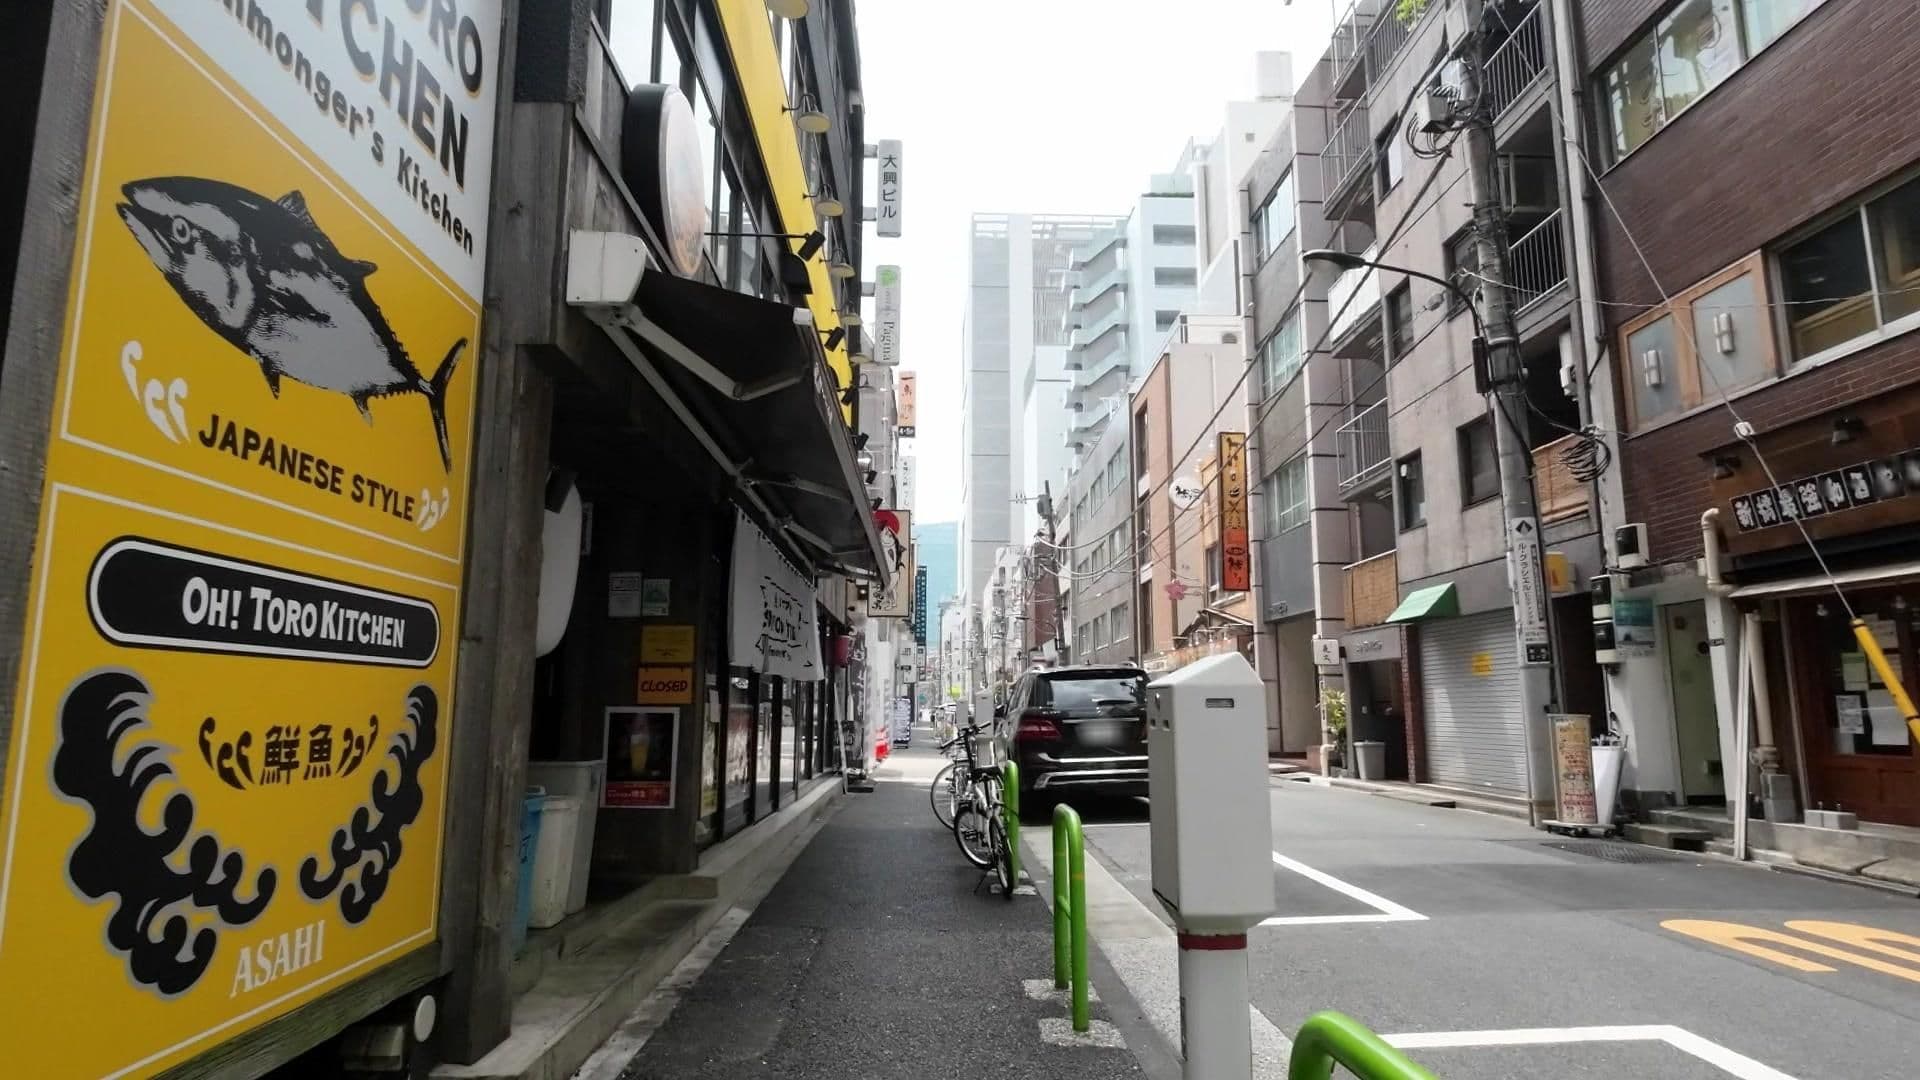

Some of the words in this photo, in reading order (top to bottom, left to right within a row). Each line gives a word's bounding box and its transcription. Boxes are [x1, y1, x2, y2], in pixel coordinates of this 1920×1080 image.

[398, 148, 475, 257] Kitchen
[881, 154, 898, 219] 大興ビル
[198, 413, 343, 496] JAPANESE
[351, 474, 416, 522] STYLE
[250, 587, 318, 638] TORO
[320, 600, 405, 649] KITCHEN
[639, 679, 688, 694] CLOSED
[260, 722, 333, 786] 鮮魚
[229, 919, 327, 999] ASAHI
